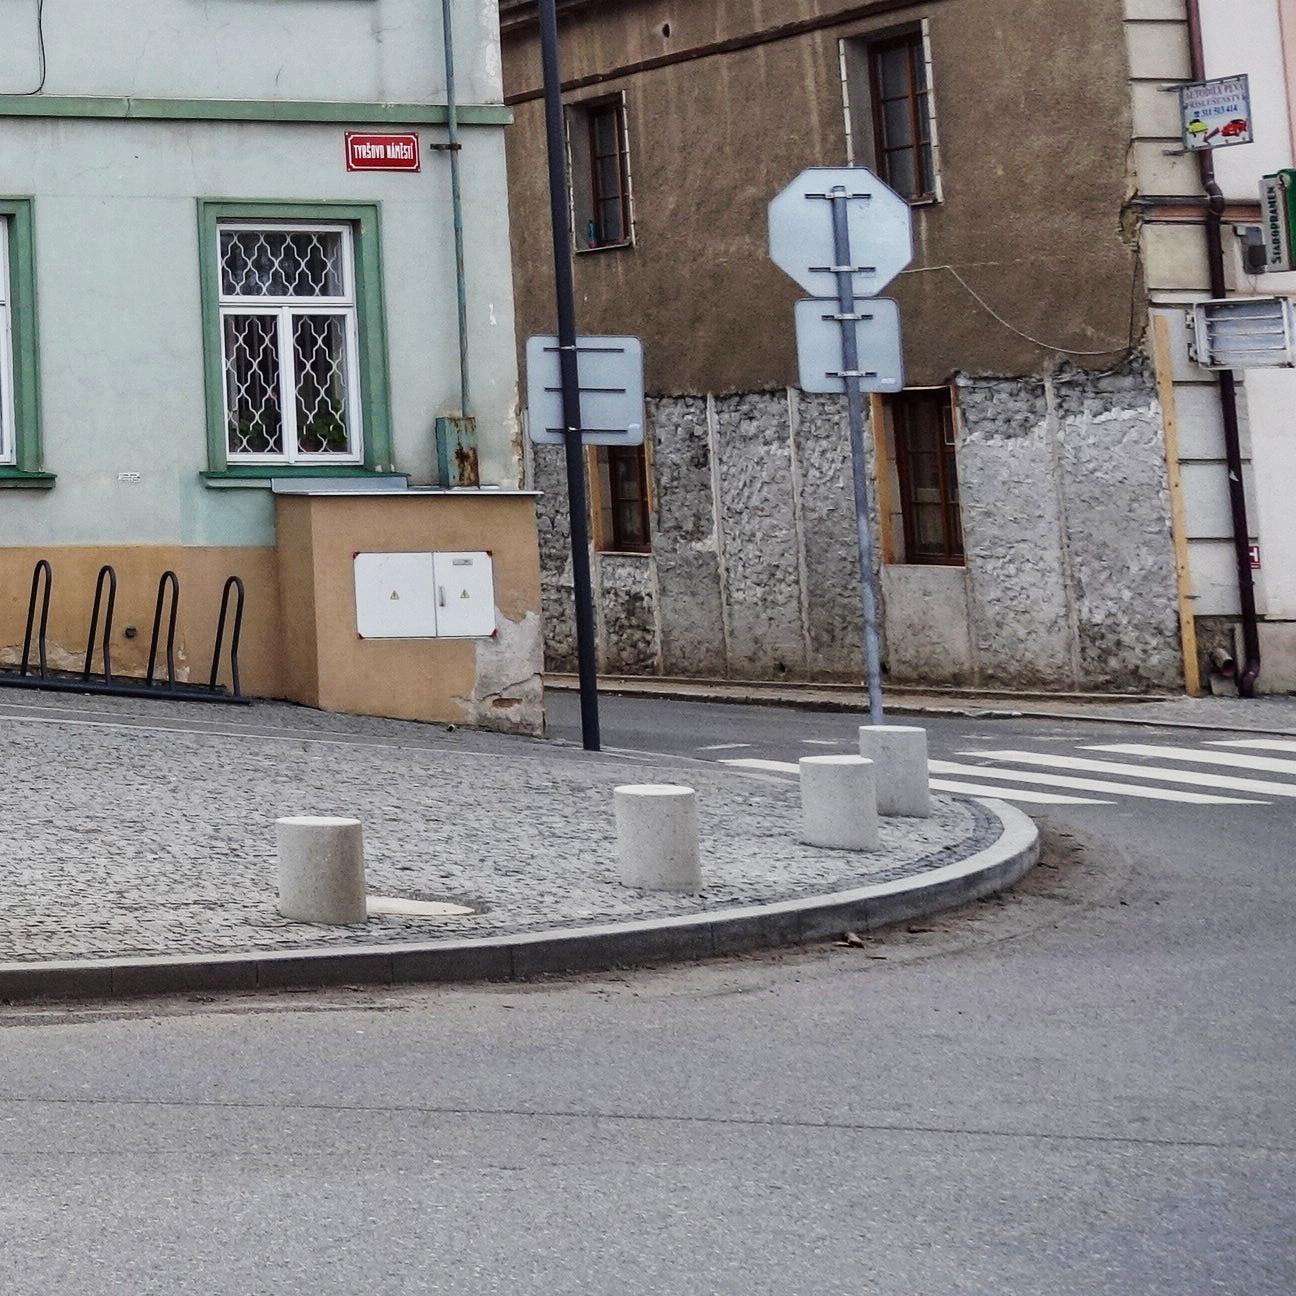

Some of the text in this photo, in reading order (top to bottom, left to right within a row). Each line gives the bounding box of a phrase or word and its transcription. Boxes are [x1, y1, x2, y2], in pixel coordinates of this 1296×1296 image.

[353, 142, 414, 160] TYRŠOVO NÁMĚSTÍ
[1267, 186, 1283, 264] STAROPRAMEN
